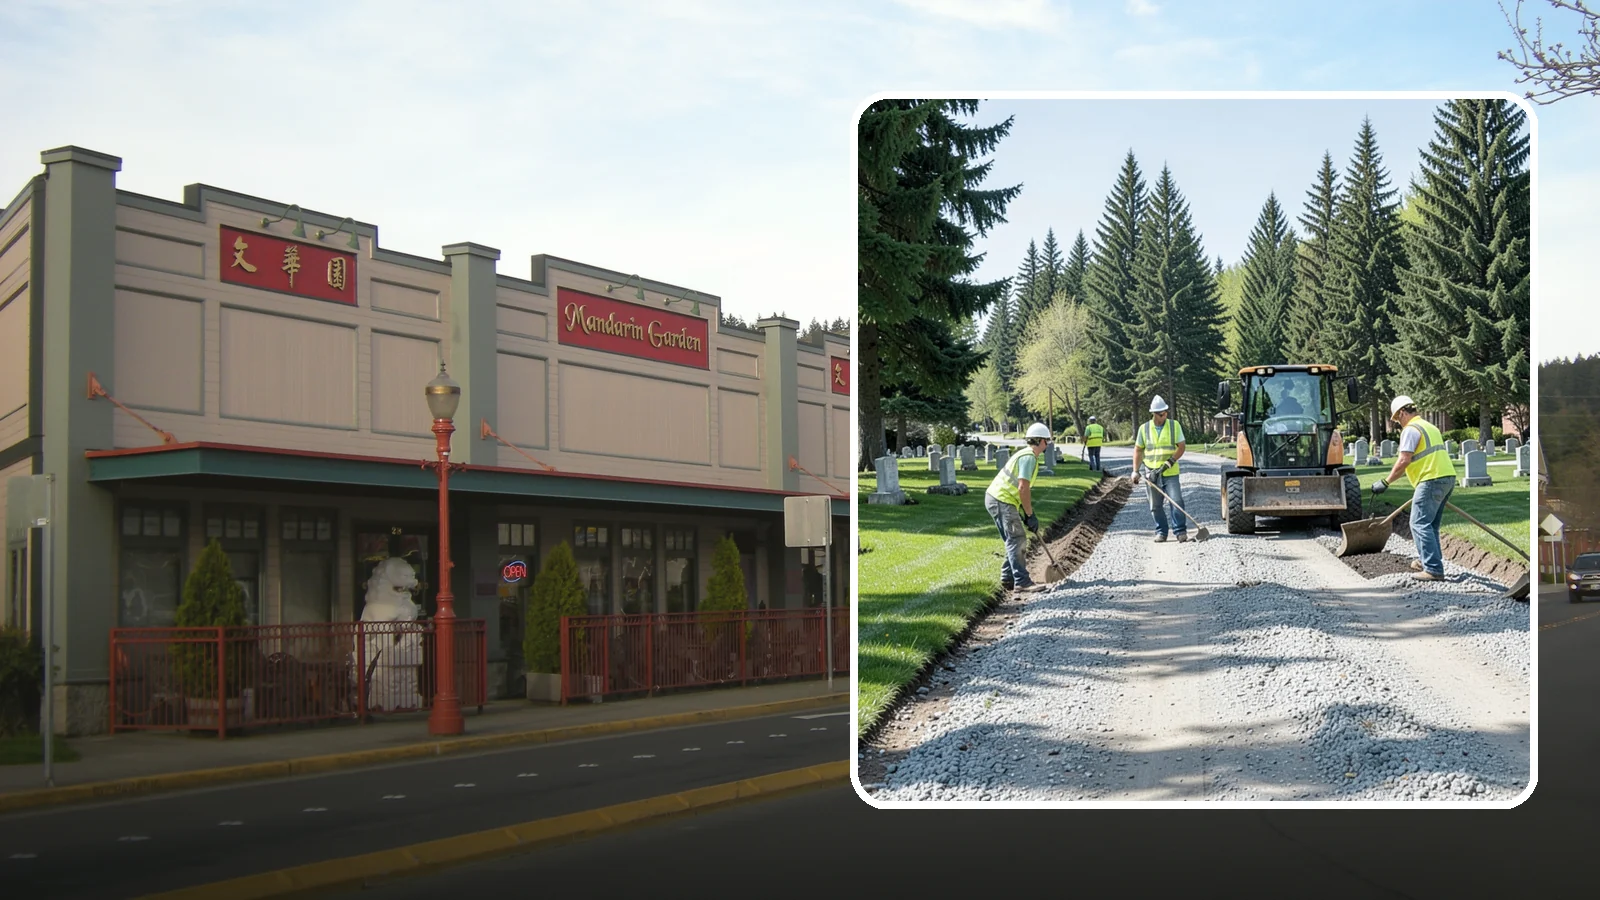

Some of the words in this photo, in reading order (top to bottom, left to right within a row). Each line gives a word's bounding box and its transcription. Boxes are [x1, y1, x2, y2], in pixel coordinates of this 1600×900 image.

[231, 236, 346, 291] 文華園
[564, 302, 644, 342] Mandarin
[647, 320, 702, 353] Garden
[834, 363, 846, 386] 文
[503, 565, 527, 579] OPEN
